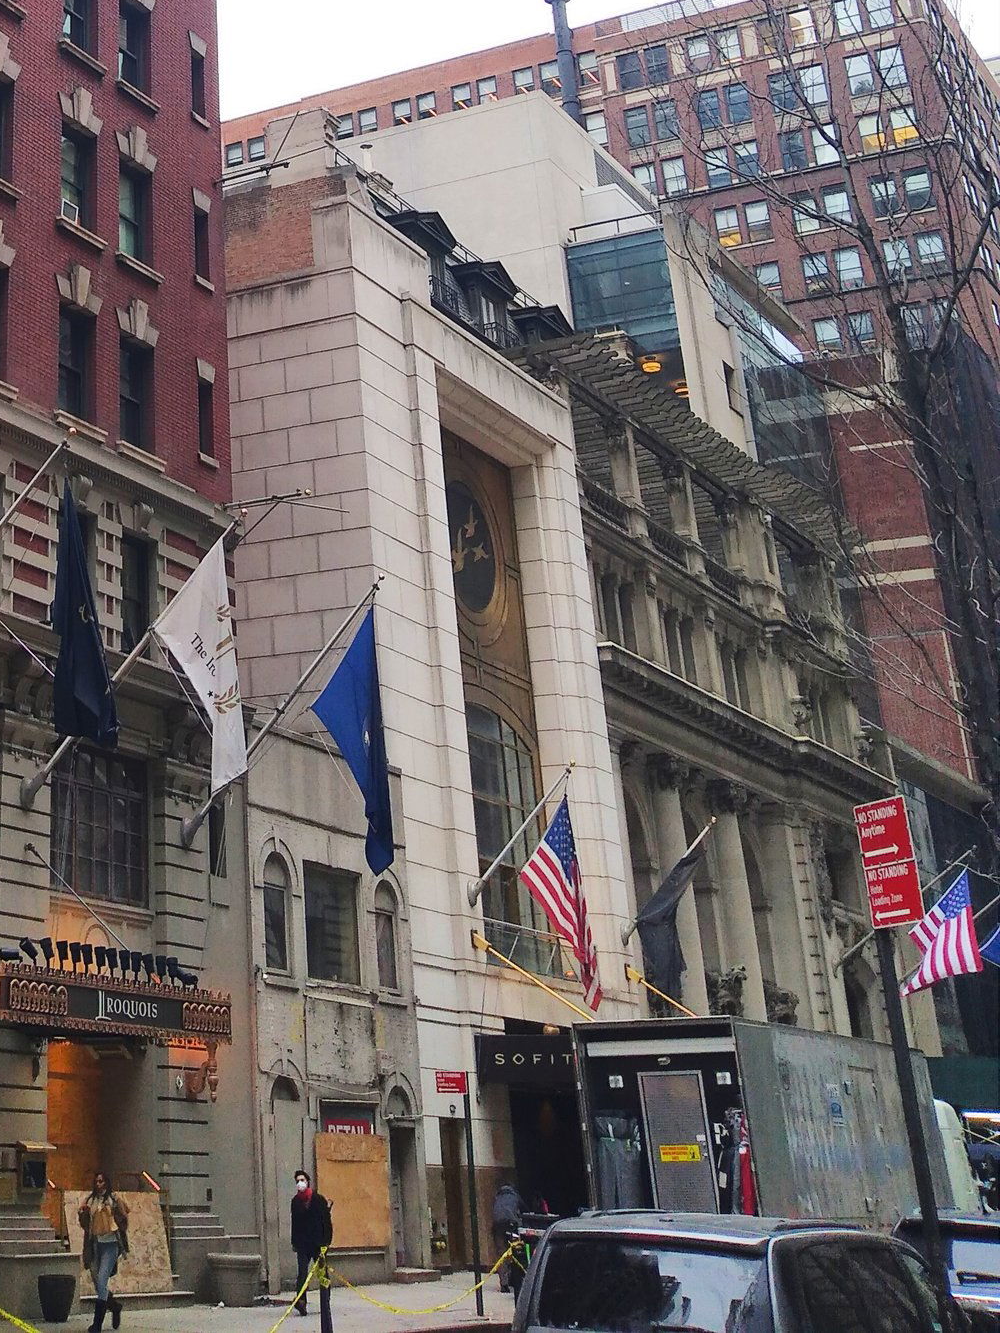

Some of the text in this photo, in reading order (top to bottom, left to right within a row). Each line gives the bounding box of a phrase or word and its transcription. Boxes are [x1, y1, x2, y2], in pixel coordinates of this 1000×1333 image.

[191, 632, 208, 659] The
[857, 805, 897, 824] NO STANDING
[861, 824, 886, 840] Anytime
[867, 864, 909, 882] NO STANDING
[872, 893, 903, 907] Loading Zone
[95, 990, 159, 1022] IROQUOIS
